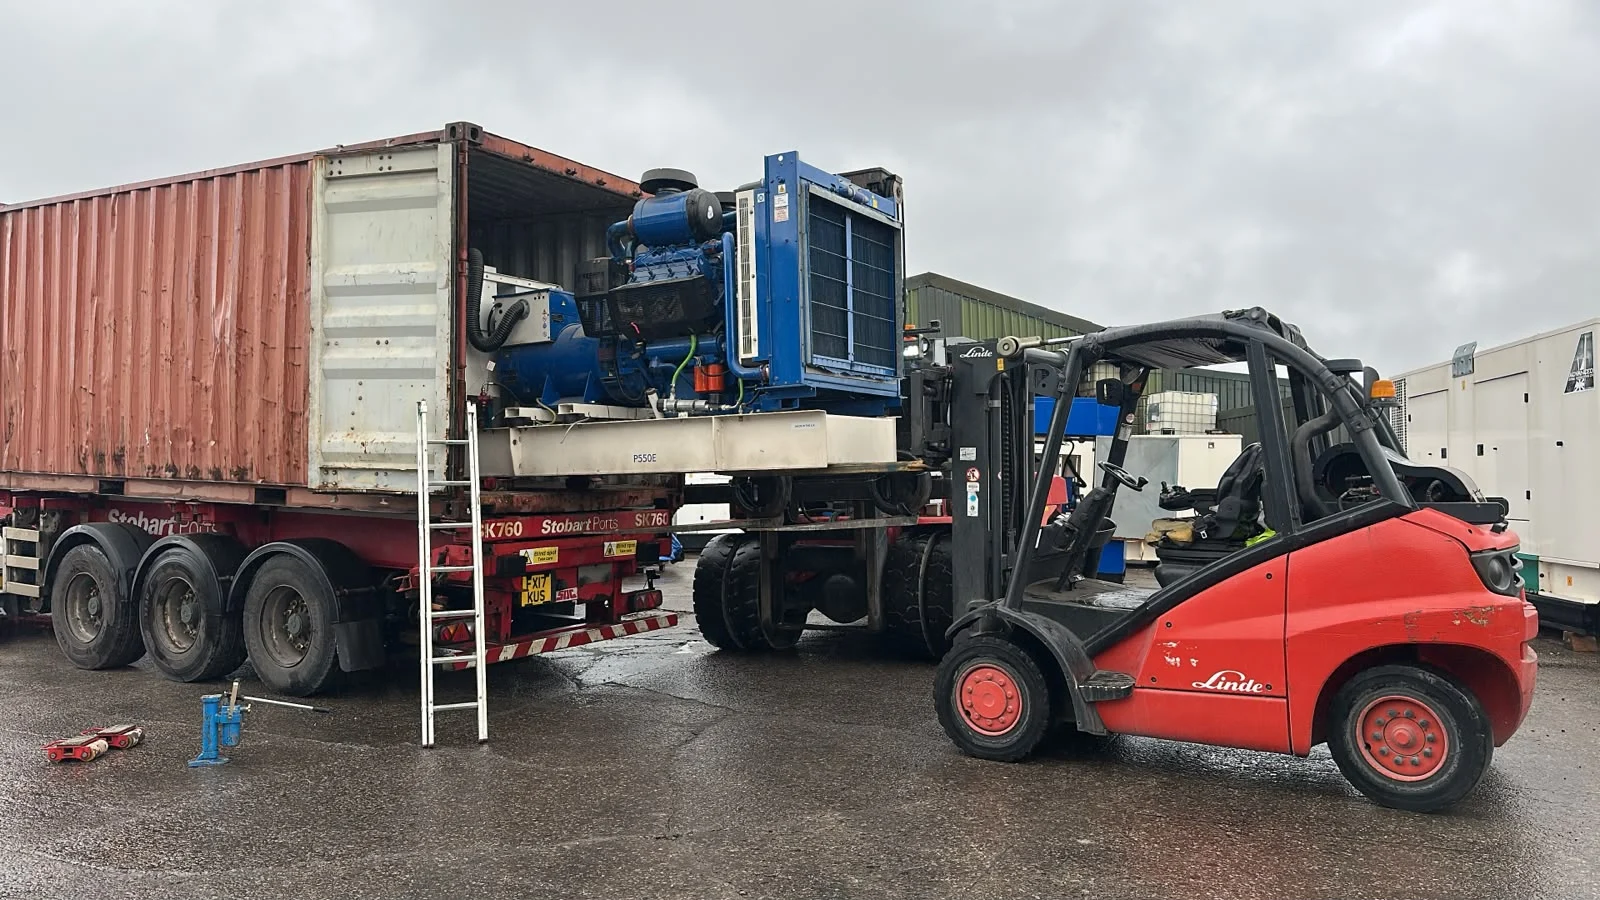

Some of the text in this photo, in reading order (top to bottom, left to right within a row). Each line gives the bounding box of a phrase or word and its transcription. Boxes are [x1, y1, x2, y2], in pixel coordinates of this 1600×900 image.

[960, 346, 993, 358] Linde
[633, 453, 657, 463] P550E
[541, 516, 619, 534] Stobart Ports
[635, 512, 669, 527] SK760
[526, 576, 546, 590] FX17
[527, 591, 546, 604] KUS
[1191, 669, 1264, 693] Linde
